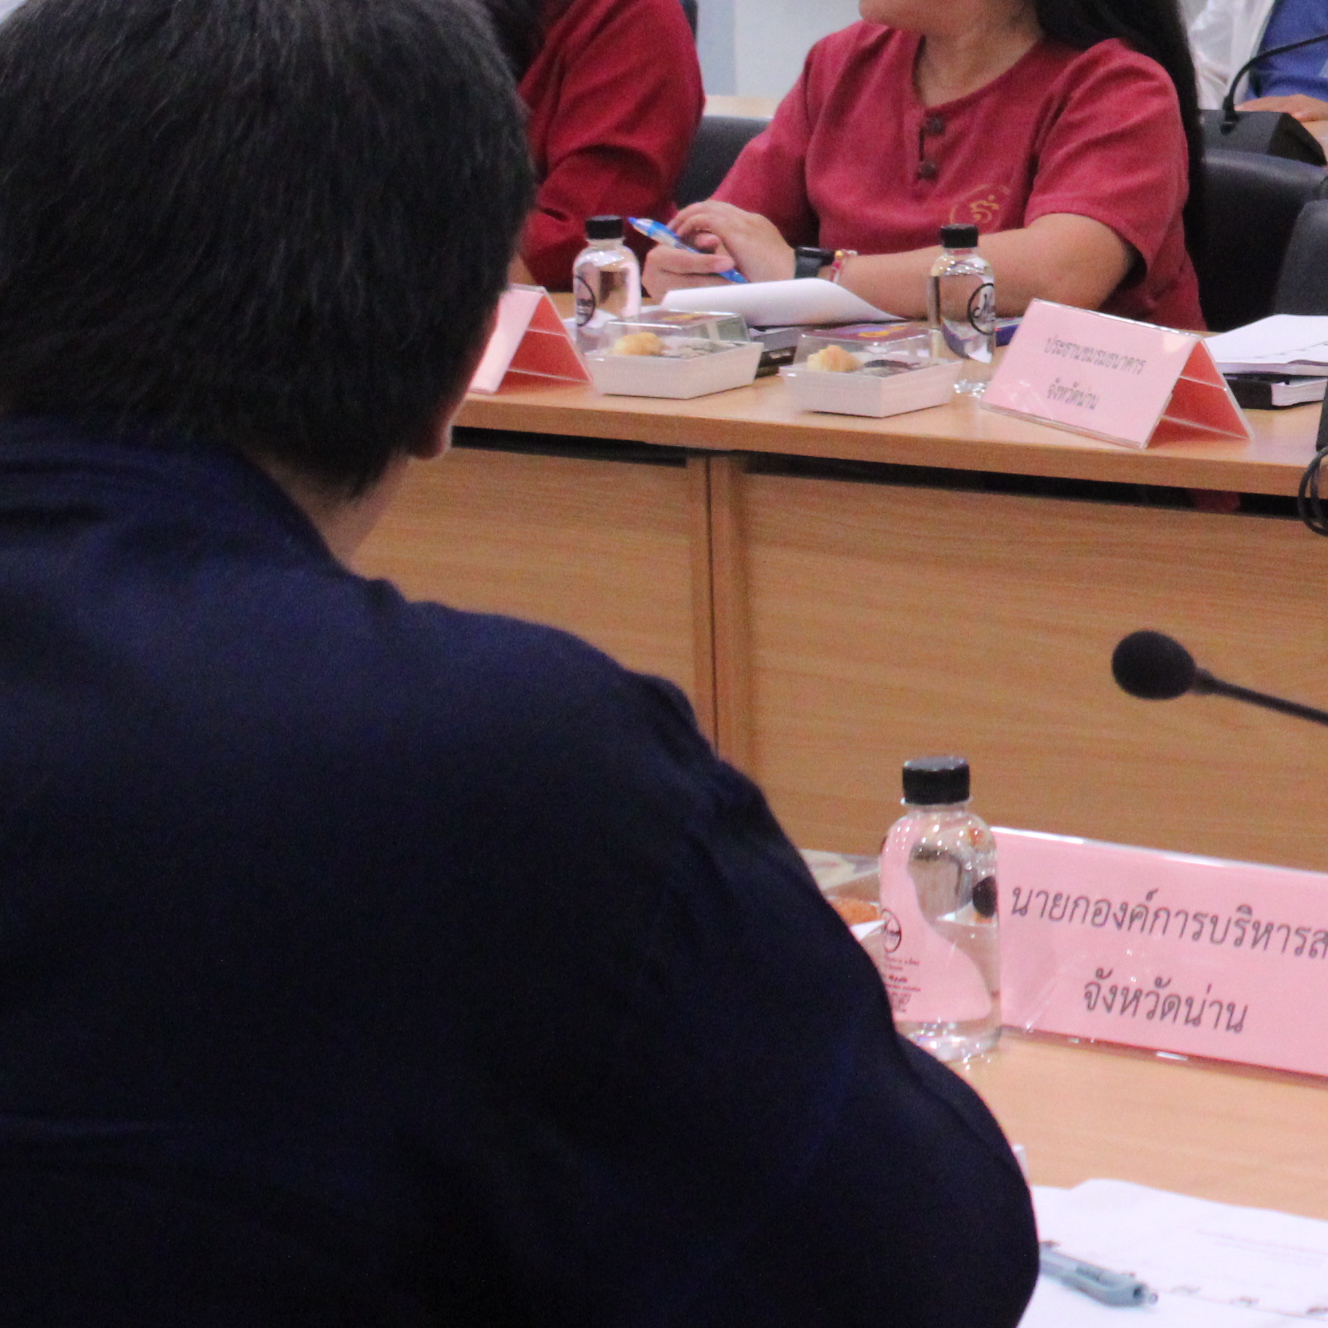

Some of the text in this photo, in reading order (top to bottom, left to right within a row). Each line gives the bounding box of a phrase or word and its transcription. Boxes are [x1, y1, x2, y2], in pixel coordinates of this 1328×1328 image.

[1084, 967, 1248, 1033] จังหวัดน่าน
